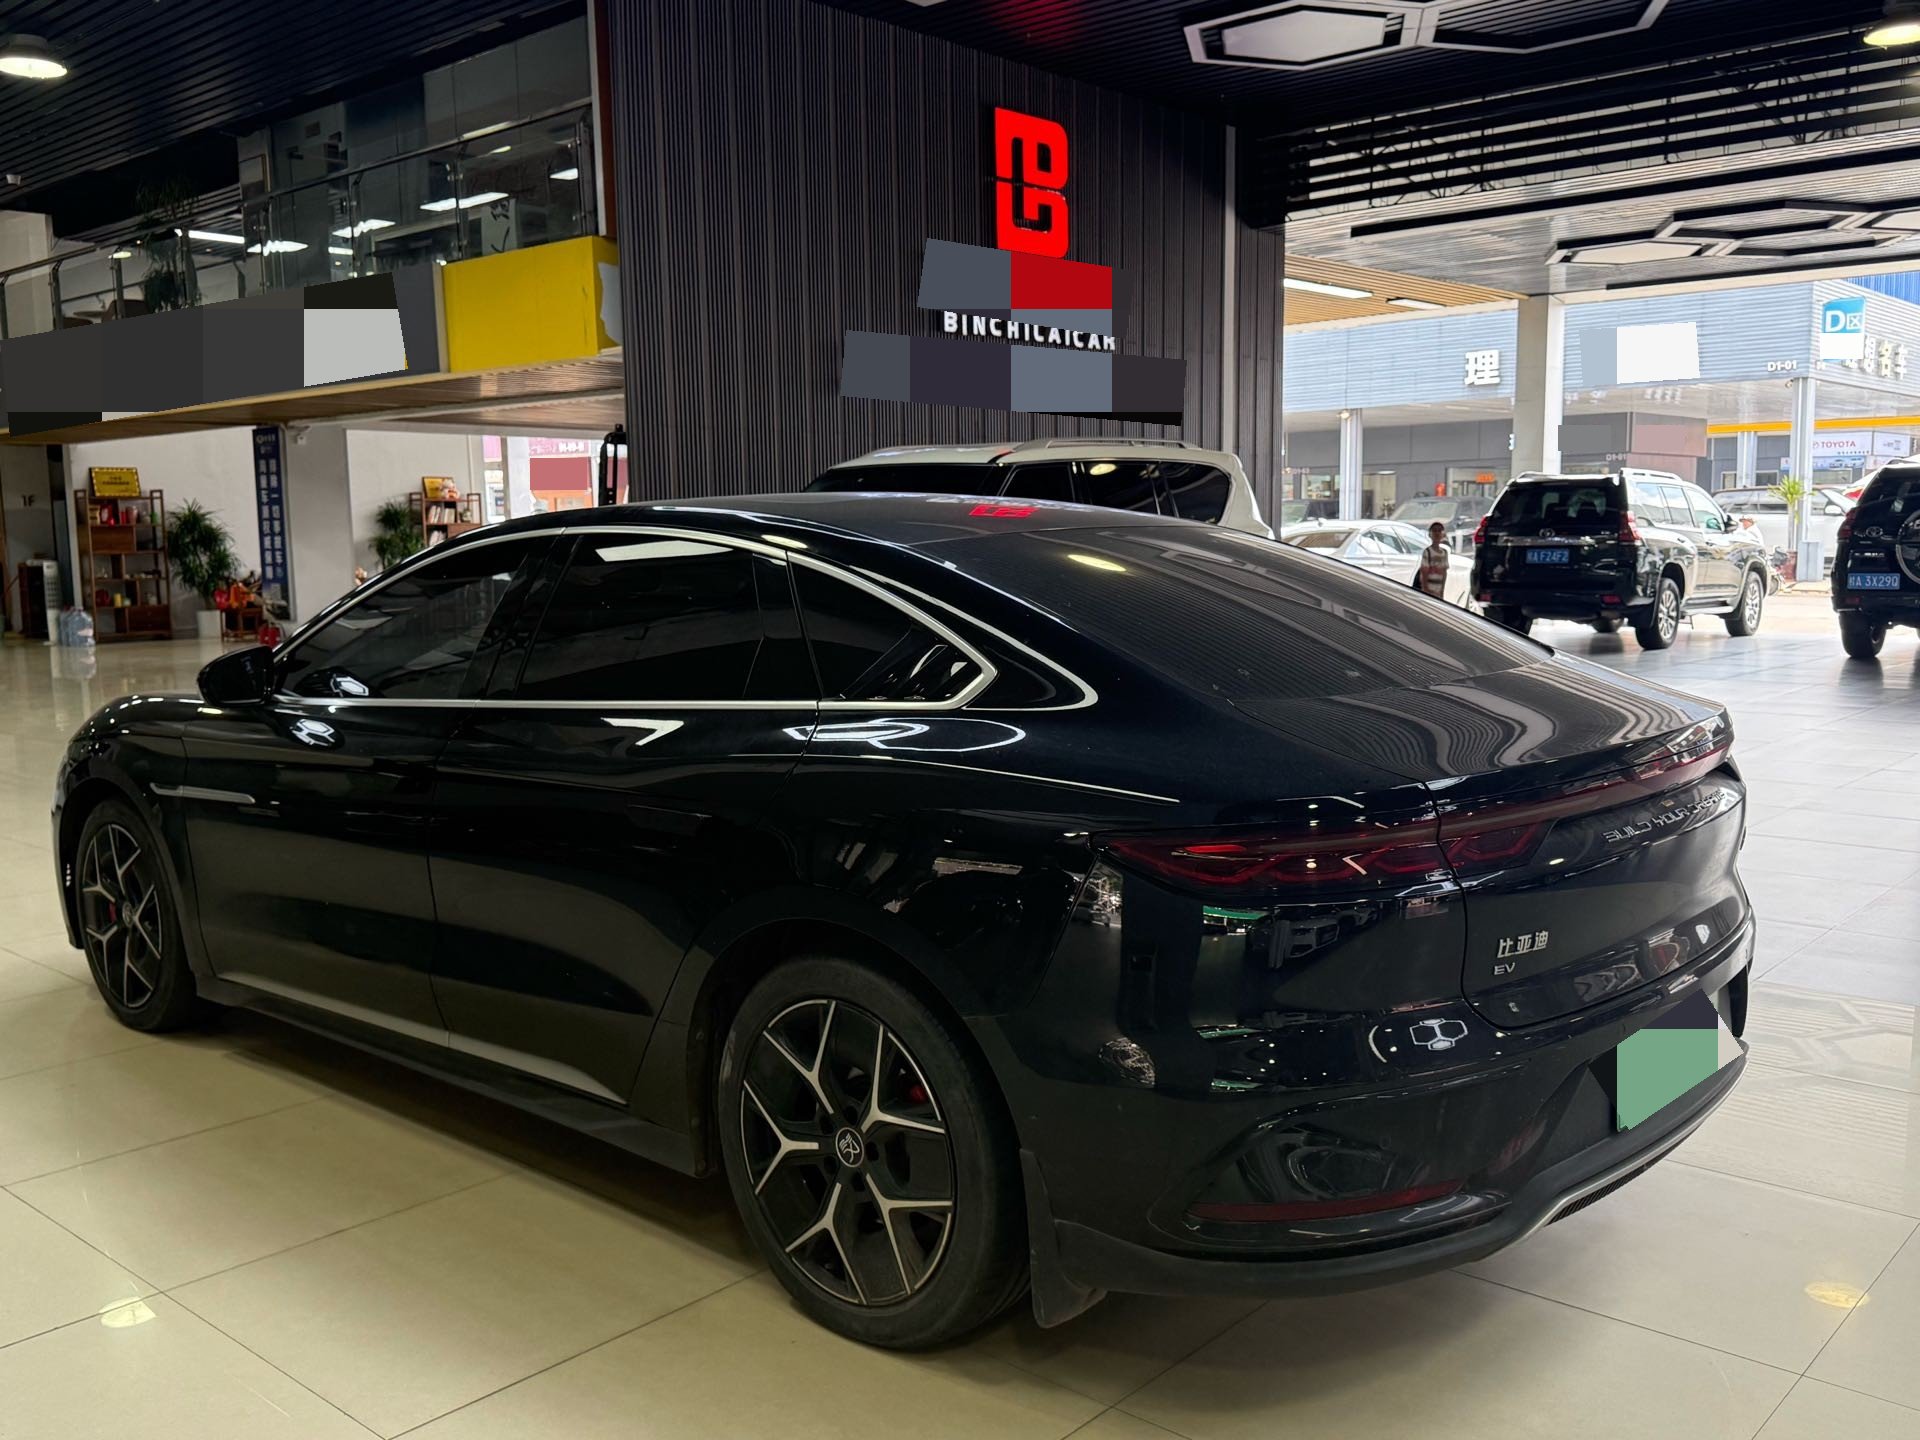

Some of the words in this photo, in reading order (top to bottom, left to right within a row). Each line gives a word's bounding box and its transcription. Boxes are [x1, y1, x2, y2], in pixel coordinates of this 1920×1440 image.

[1464, 350, 1501, 386] 理
[1766, 360, 1798, 373] D1-01
[1821, 440, 1857, 449] TOYOTA
[1602, 821, 1652, 843] BUILD
[1652, 807, 1690, 828] YOUR
[1496, 930, 1549, 958] 比亚迪
[1493, 962, 1516, 976] EV
